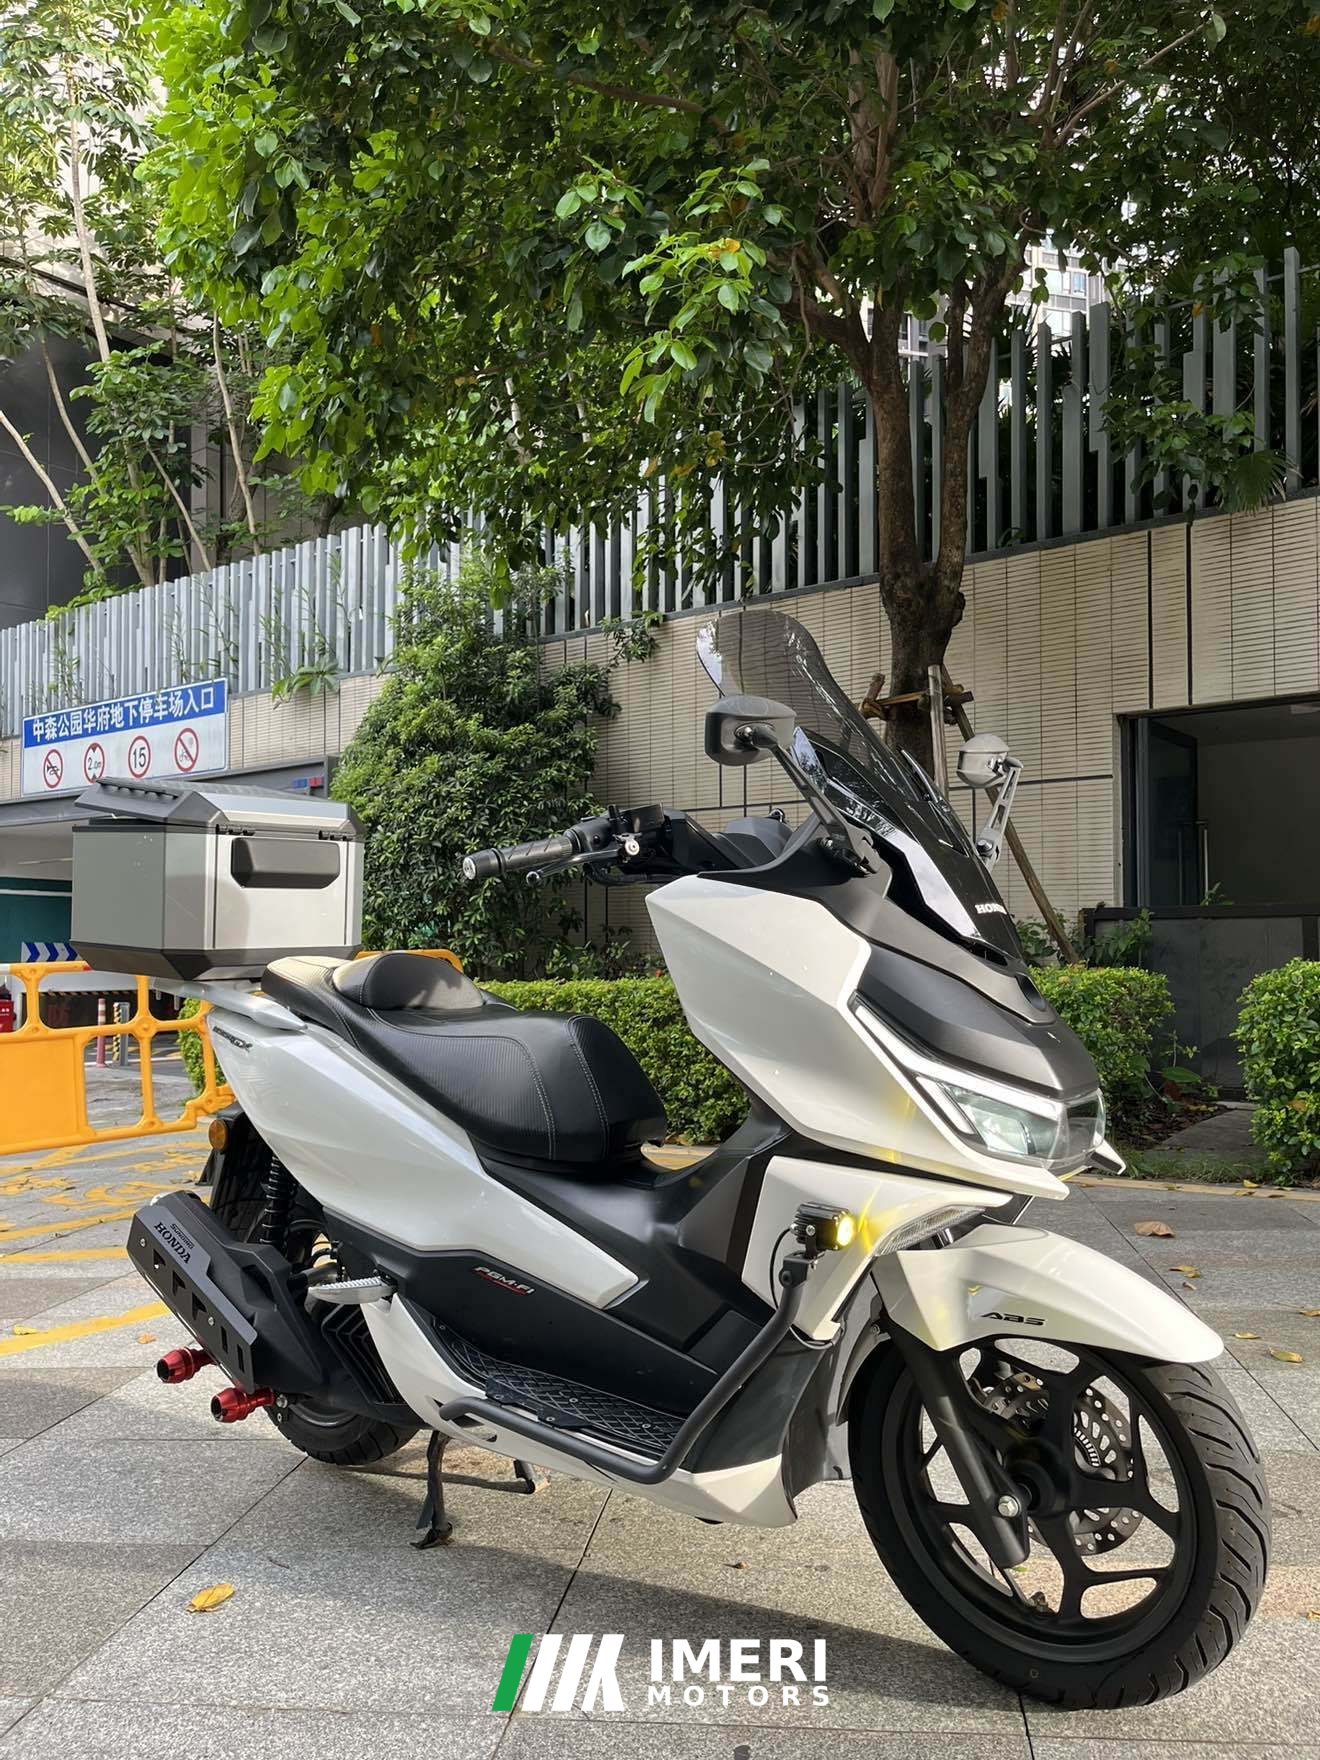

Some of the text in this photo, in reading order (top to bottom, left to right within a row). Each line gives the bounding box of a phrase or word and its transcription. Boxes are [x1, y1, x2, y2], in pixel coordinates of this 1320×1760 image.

[33, 687, 214, 742] 中森公园华府地下停车场入口
[132, 746, 147, 769] 15
[154, 1221, 191, 1264] HONDA
[980, 1312, 1046, 1326] ABS
